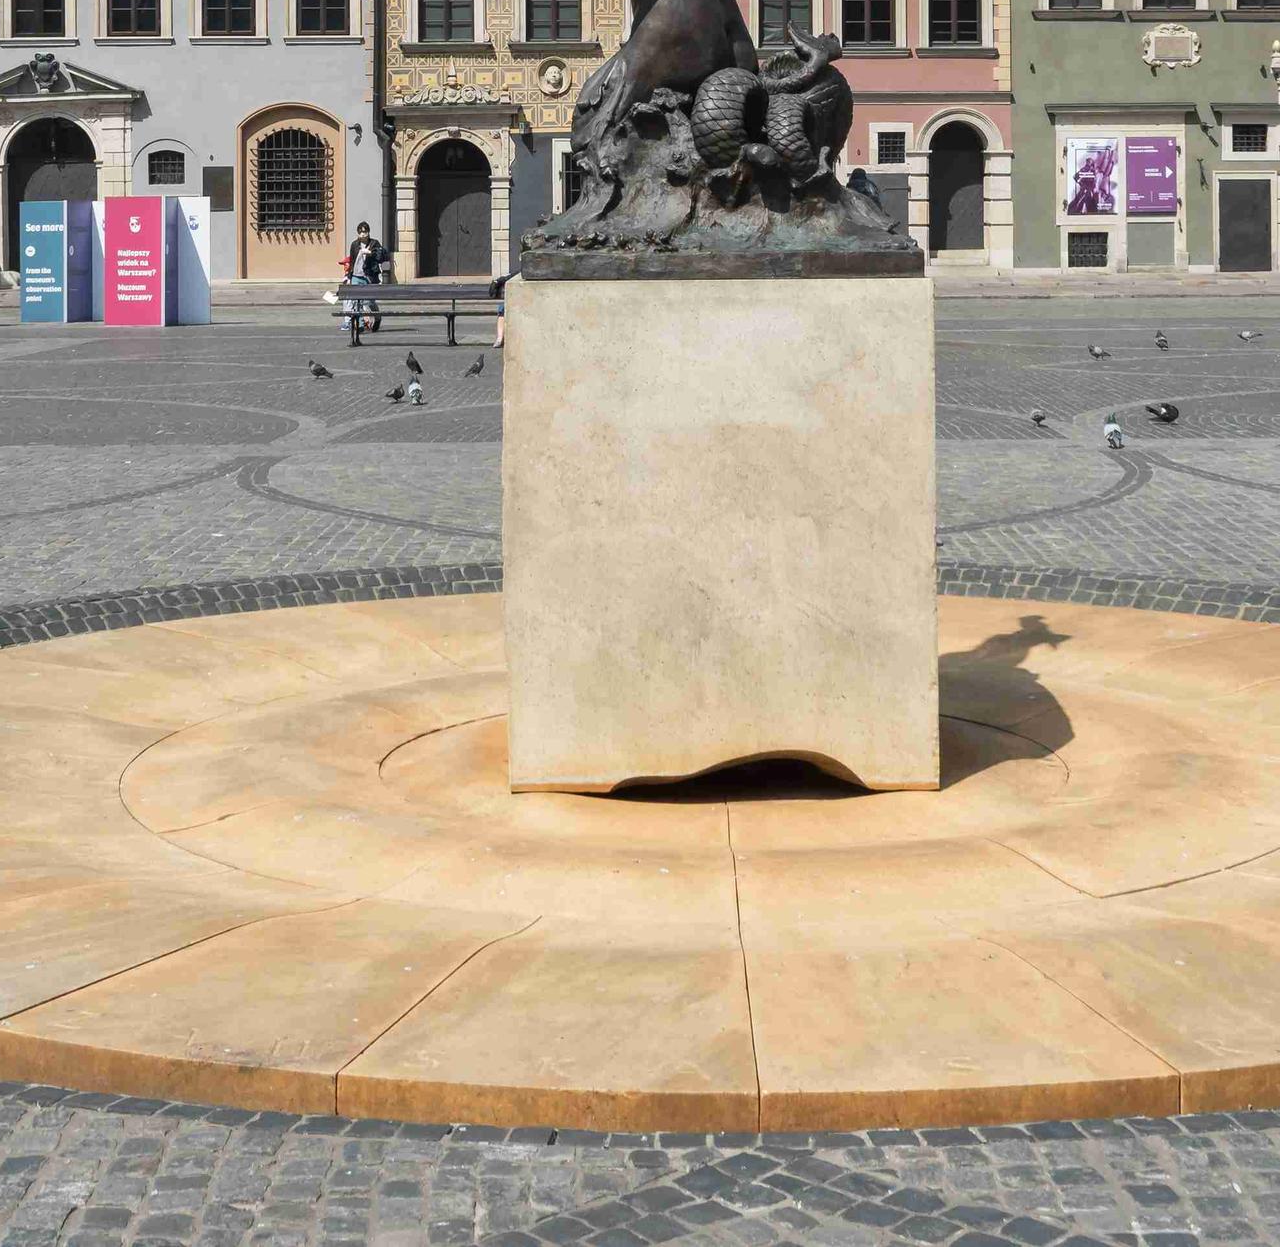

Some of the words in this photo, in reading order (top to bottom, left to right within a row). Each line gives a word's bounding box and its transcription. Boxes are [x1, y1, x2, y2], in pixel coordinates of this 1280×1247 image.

[25, 223, 41, 232] See
[42, 224, 64, 232] more
[117, 249, 150, 257] Najlepszy
[117, 269, 156, 278] Warszawę?
[25, 295, 42, 303] point
[117, 294, 153, 302] Warszawy
